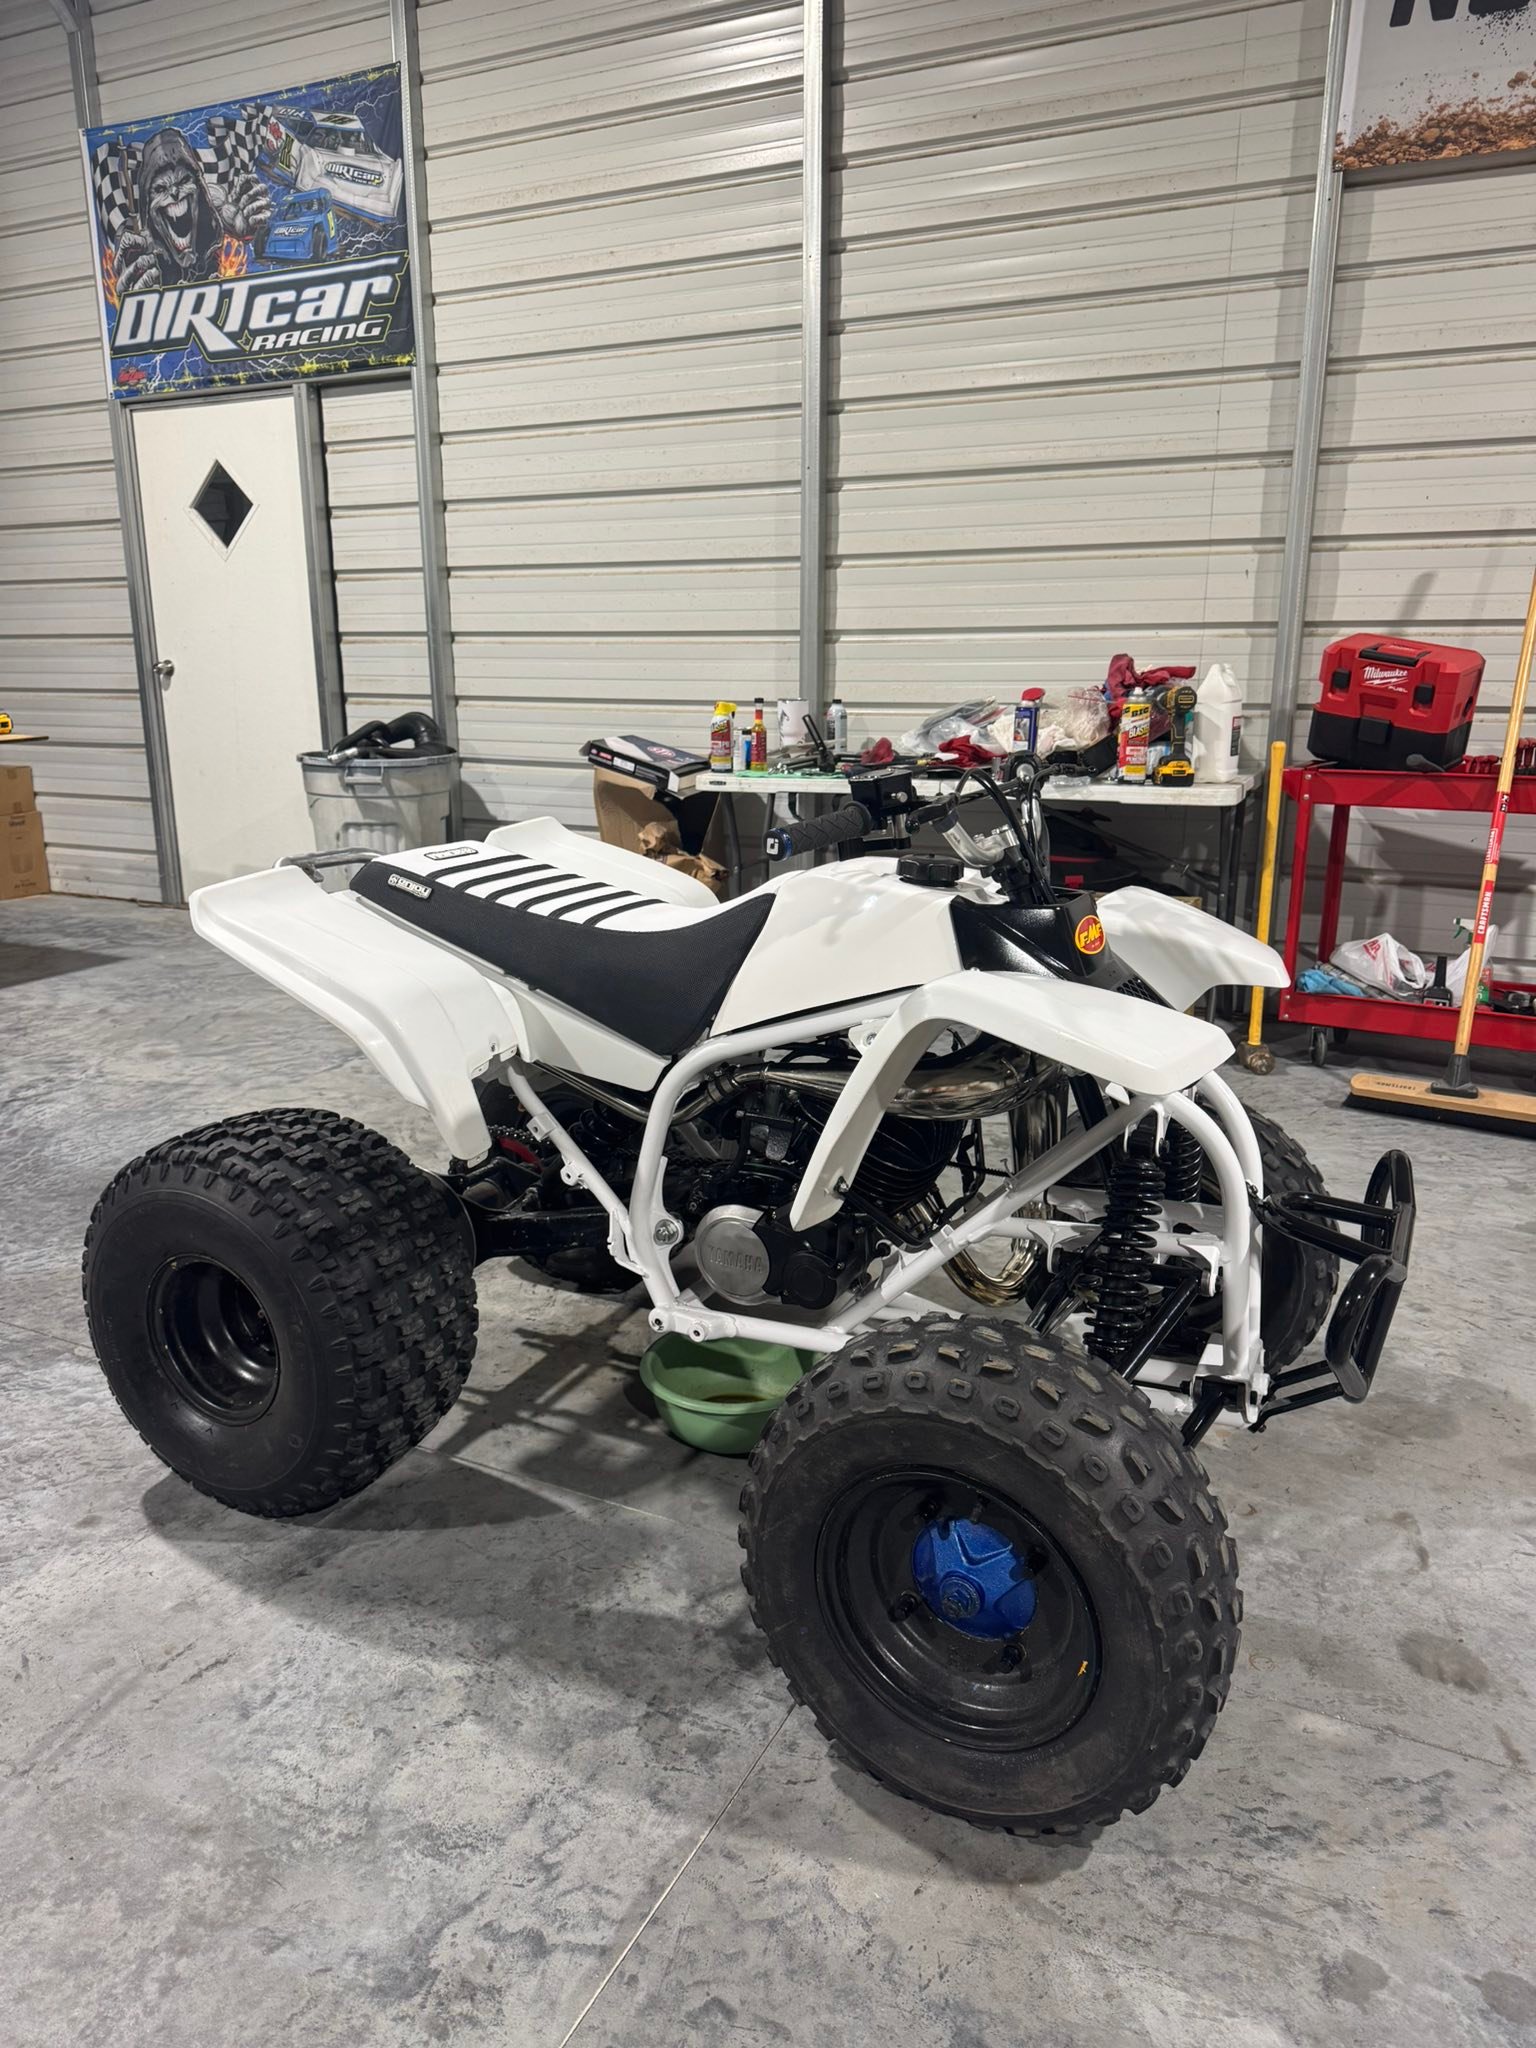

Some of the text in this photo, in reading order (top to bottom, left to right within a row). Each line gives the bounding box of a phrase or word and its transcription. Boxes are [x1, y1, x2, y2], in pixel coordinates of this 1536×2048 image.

[113, 257, 399, 351] DIRTcar
[251, 318, 385, 351] RACING
[1363, 666, 1408, 680] Milwaukee
[1478, 891, 1492, 935] CRAFTSMAN
[1080, 922, 1102, 948] FMF
[708, 1246, 764, 1274] YAMAHA
